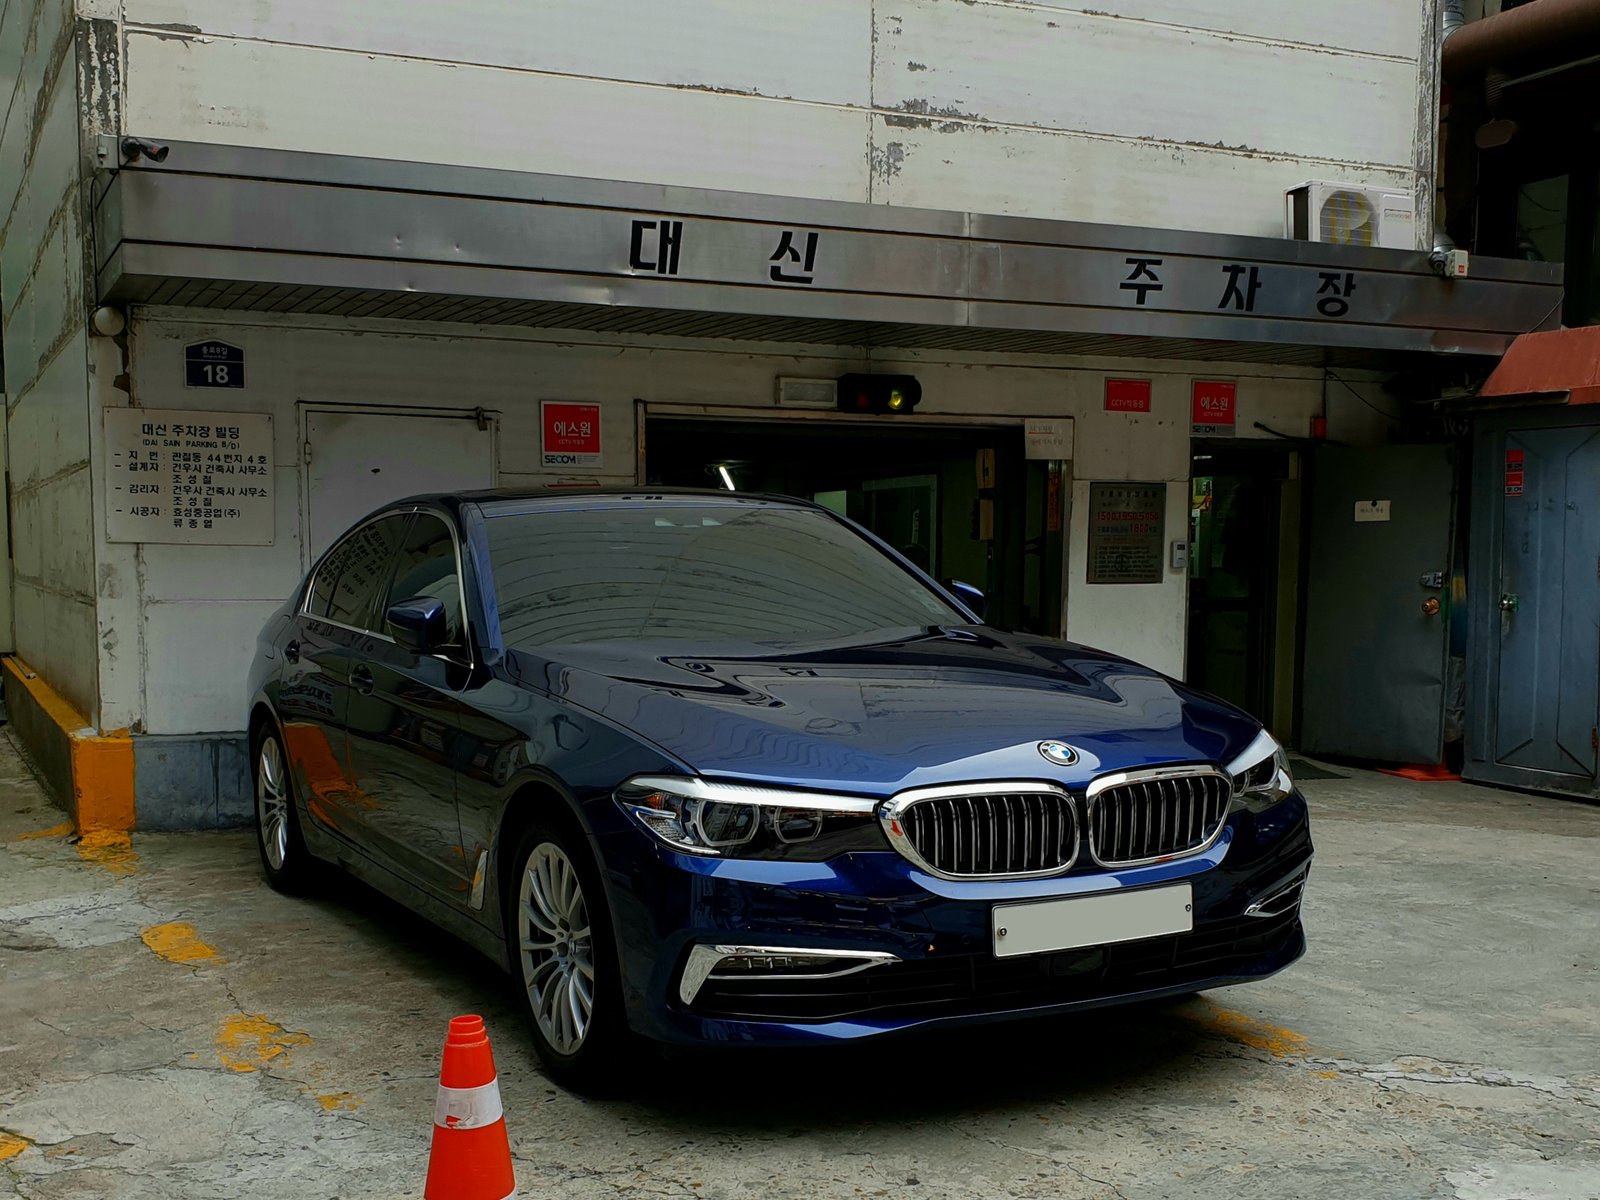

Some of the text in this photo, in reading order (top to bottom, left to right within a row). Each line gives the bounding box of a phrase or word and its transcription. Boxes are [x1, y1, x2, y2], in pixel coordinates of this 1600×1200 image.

[202, 364, 229, 384] 18
[1200, 396, 1228, 411] 에스원
[142, 424, 240, 440] 대신 주차장 빌딩
[553, 421, 591, 437] 에스원
[186, 440, 218, 448] PARKING
[544, 455, 576, 464] SECOM
[238, 465, 268, 475] 사무소
[238, 487, 268, 497] 사무소
